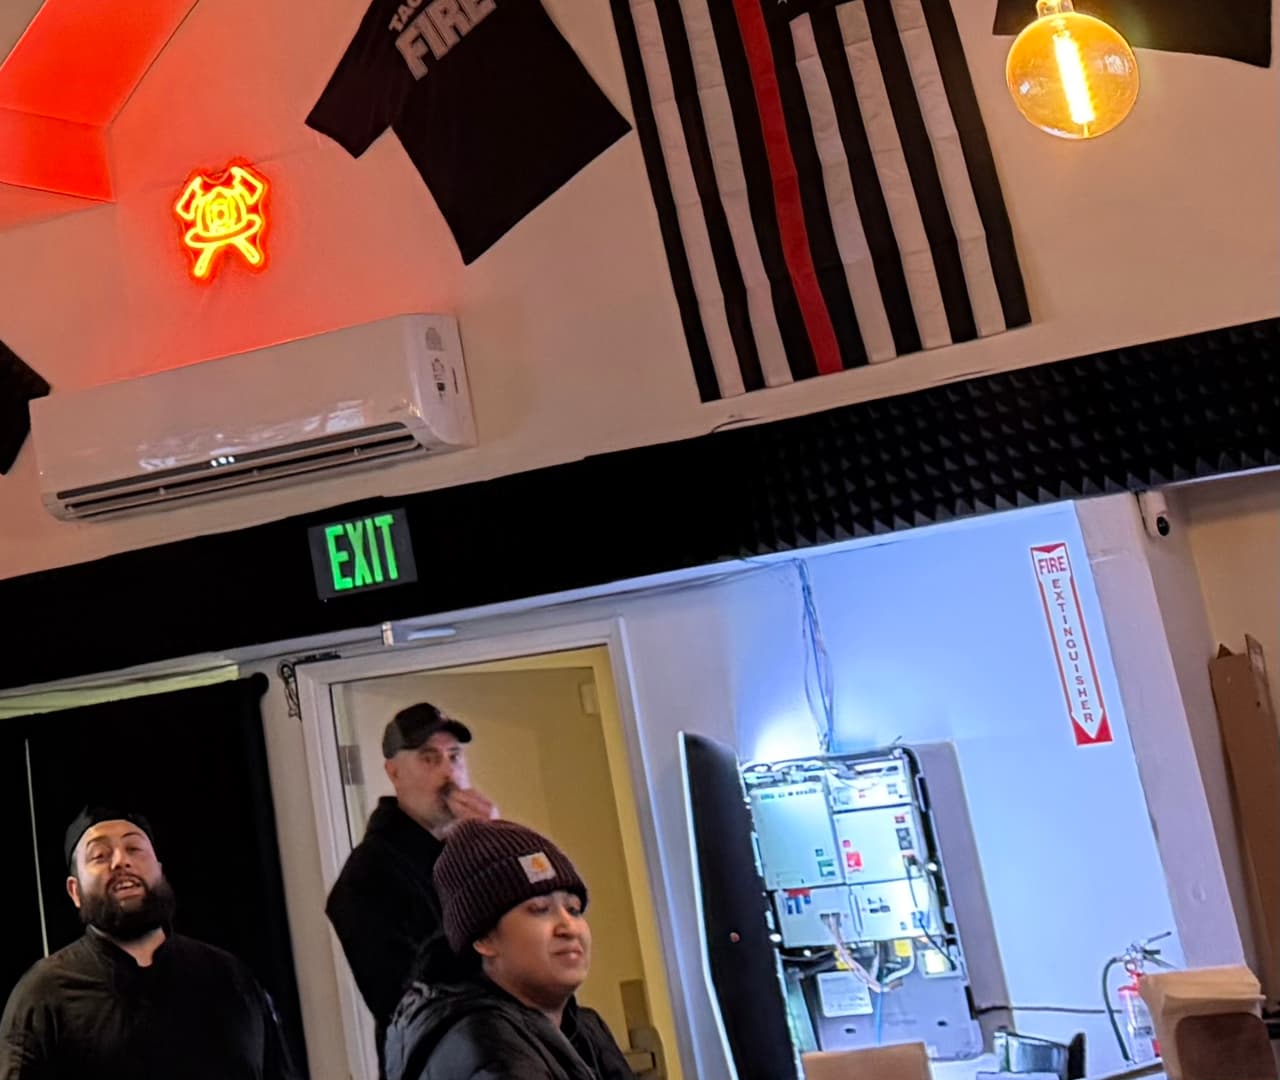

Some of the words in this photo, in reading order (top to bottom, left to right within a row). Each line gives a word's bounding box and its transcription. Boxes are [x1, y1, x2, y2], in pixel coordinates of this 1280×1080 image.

[395, 0, 497, 80] FIRE
[325, 514, 399, 590] EXIT
[1038, 556, 1067, 575] FIRE
[1052, 578, 1094, 723] EXTINGUISHER
